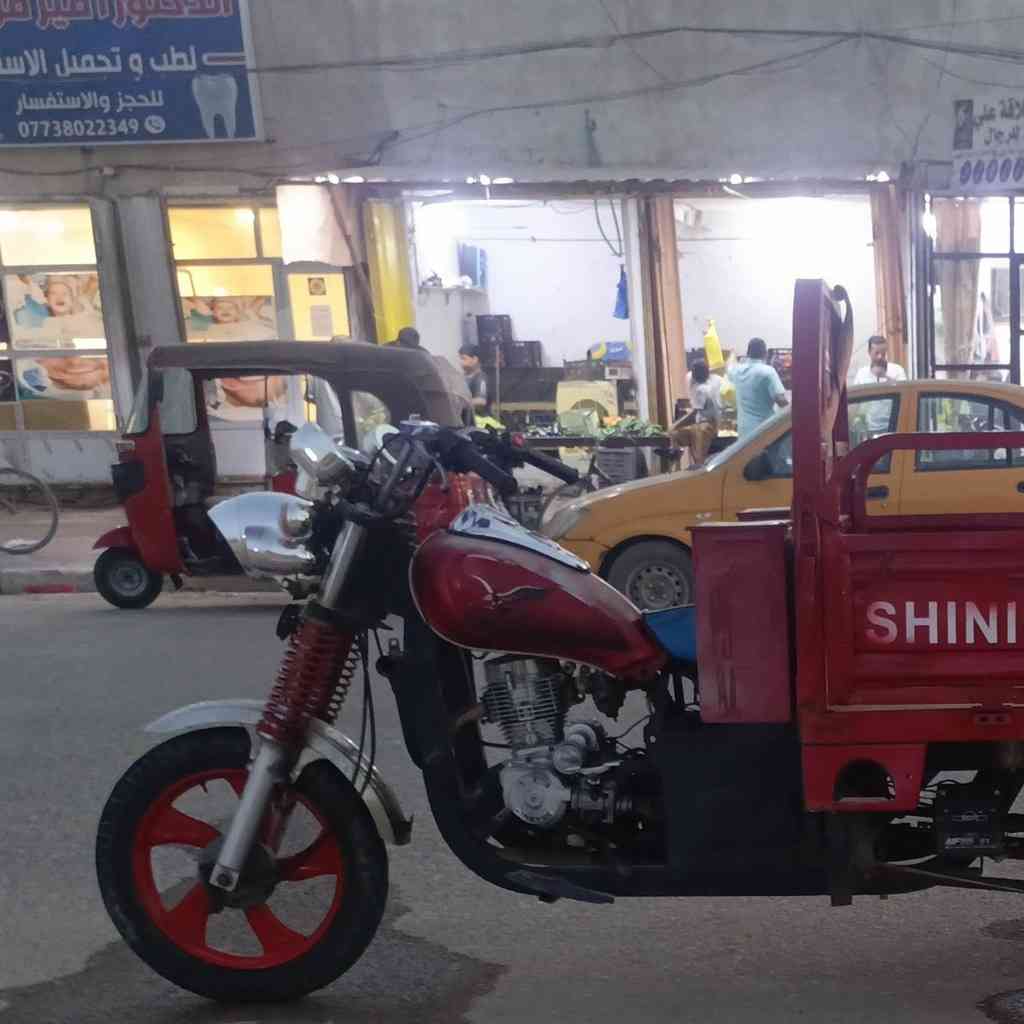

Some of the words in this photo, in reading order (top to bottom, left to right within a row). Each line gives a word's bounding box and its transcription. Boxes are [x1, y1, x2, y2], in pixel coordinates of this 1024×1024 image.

[55, 46, 122, 78] تجميل
[128, 52, 144, 81] و
[16, 91, 111, 115] والاستفسار
[116, 90, 164, 113] للحجز
[18, 118, 139, 138] 07738022349
